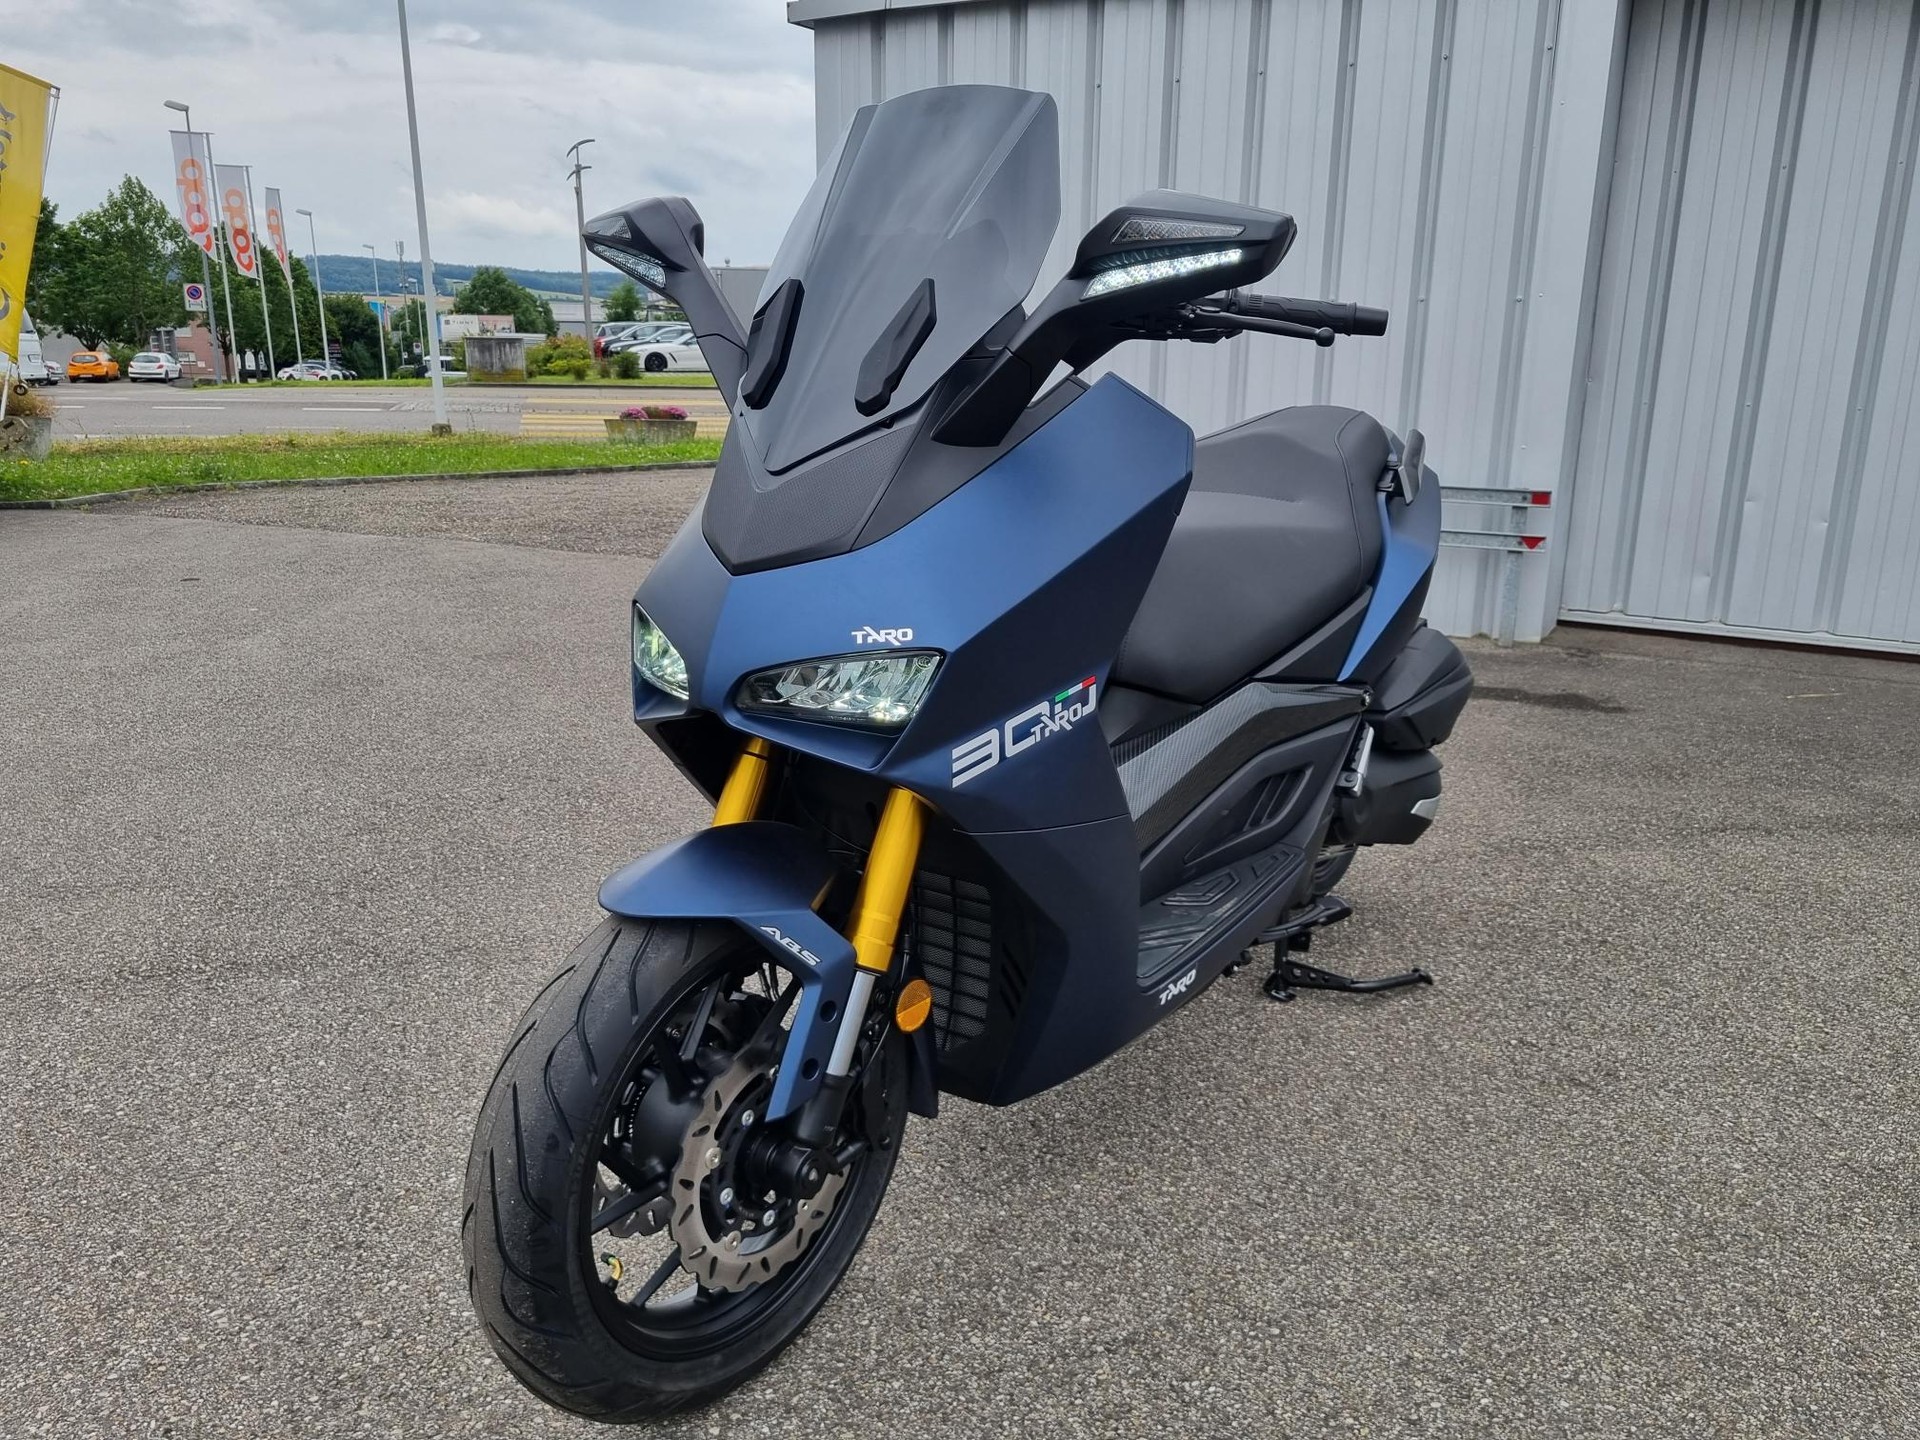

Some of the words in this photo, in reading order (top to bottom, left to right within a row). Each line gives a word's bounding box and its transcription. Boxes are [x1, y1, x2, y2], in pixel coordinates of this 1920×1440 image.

[851, 626, 913, 646] TARO
[1031, 702, 1082, 742] TARO
[760, 926, 821, 966] ABS
[1159, 969, 1197, 1005] TARO
